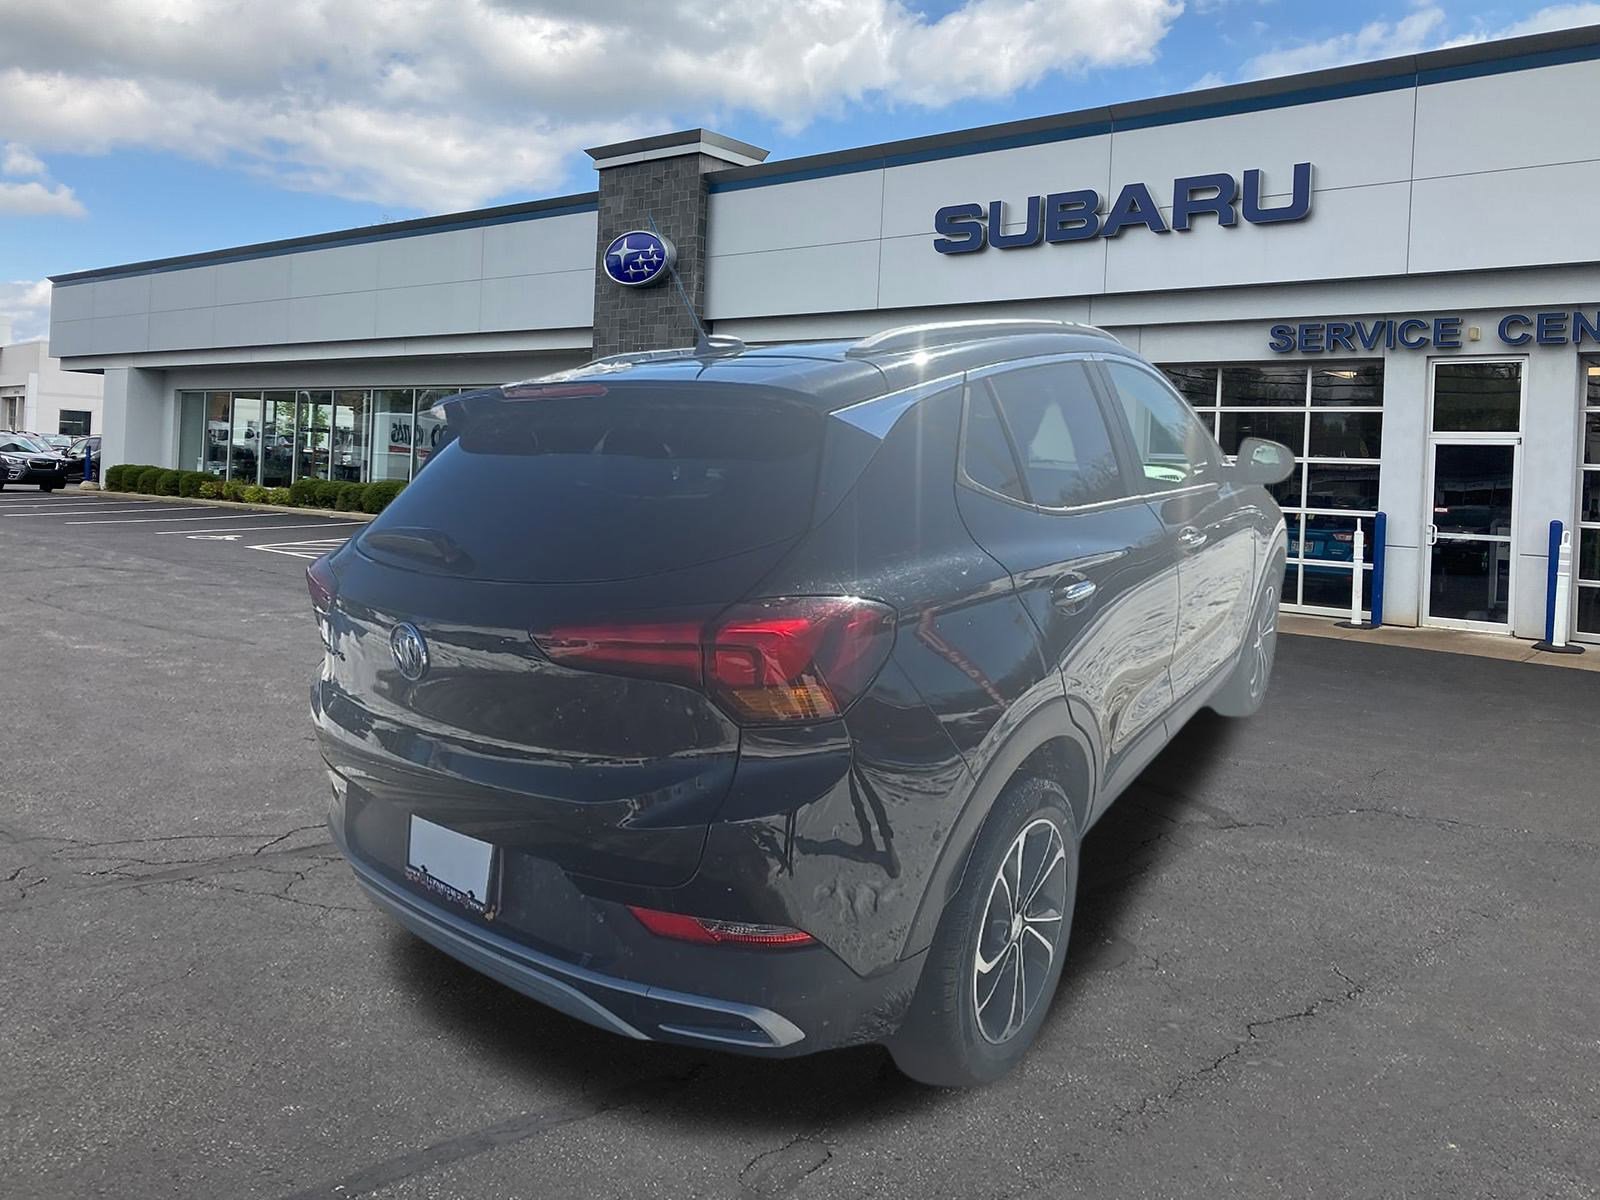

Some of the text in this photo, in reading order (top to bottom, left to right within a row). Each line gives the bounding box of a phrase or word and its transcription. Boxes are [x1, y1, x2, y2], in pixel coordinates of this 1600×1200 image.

[933, 161, 1314, 255] SUBARU
[1269, 311, 1600, 353] SERVICE CEN
